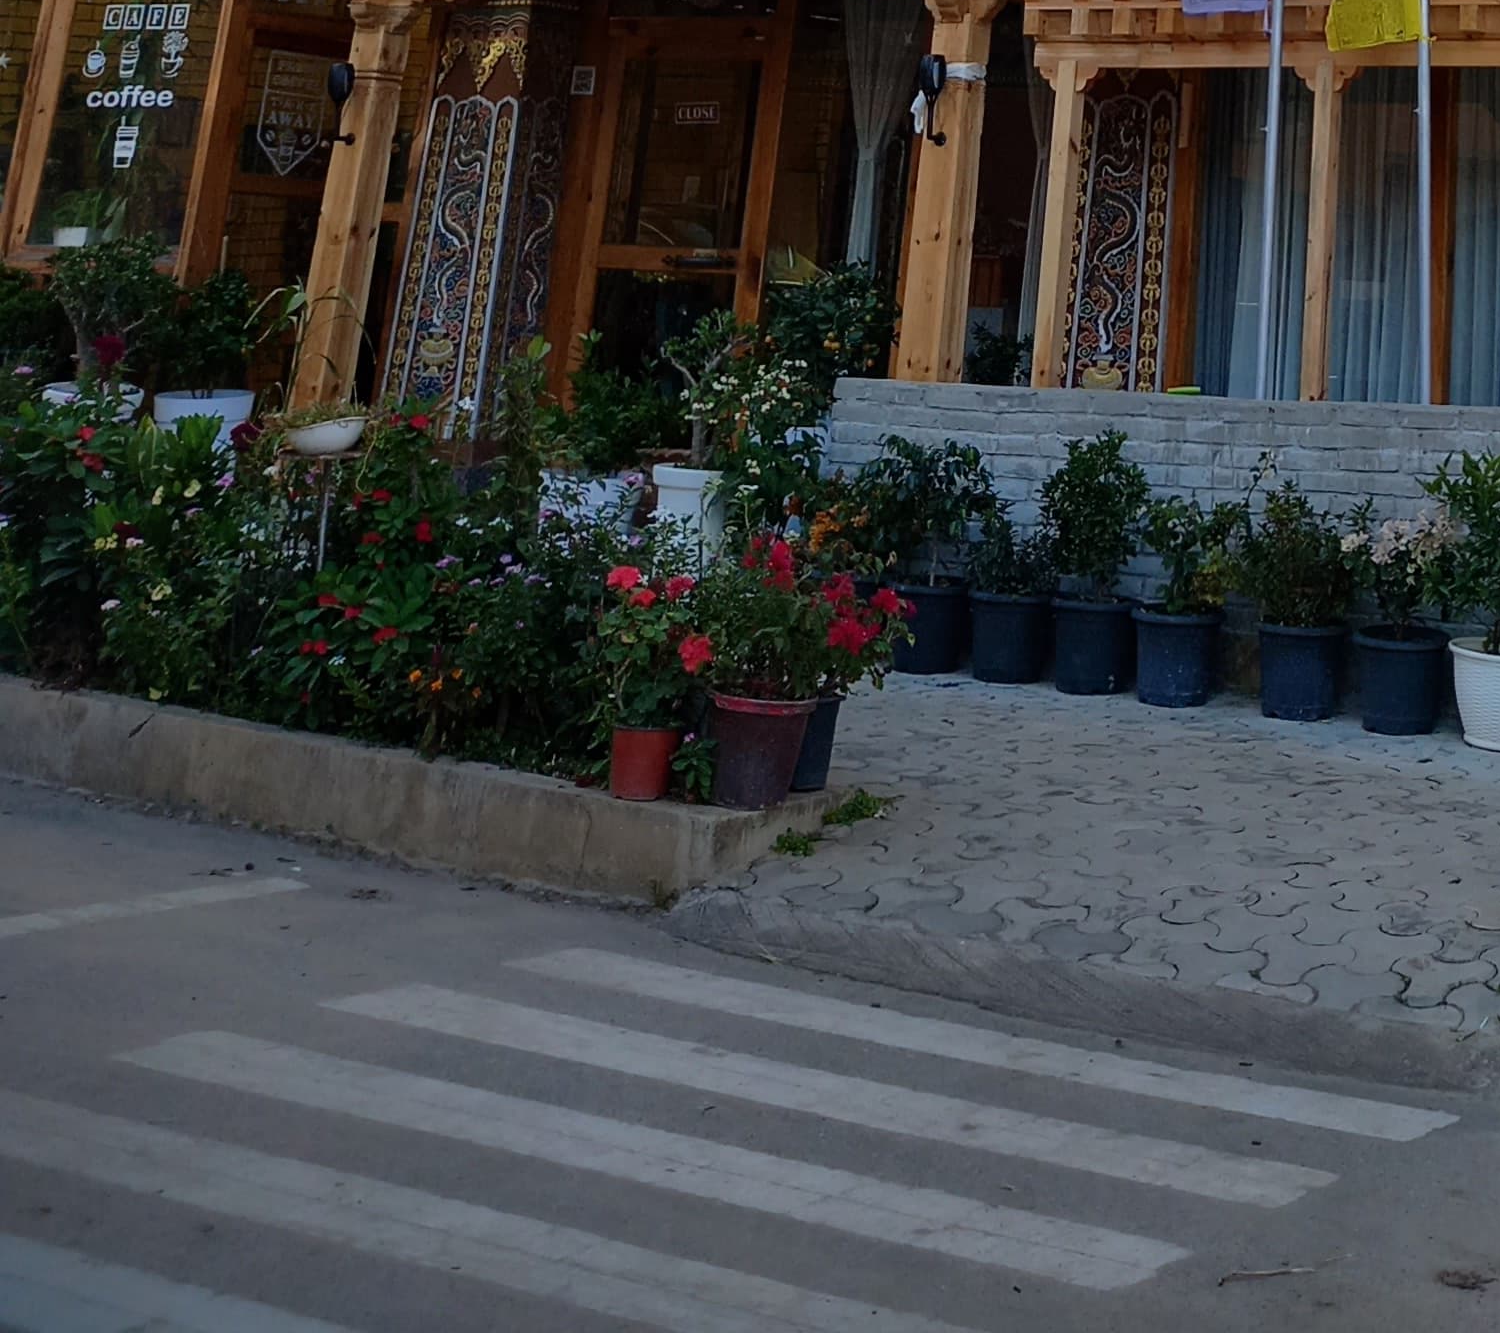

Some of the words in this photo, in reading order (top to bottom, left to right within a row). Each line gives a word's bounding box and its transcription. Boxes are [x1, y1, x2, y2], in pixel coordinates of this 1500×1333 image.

[106, 6, 187, 26] CAFE
[86, 84, 174, 107] coffee
[265, 110, 316, 129] AWAY
